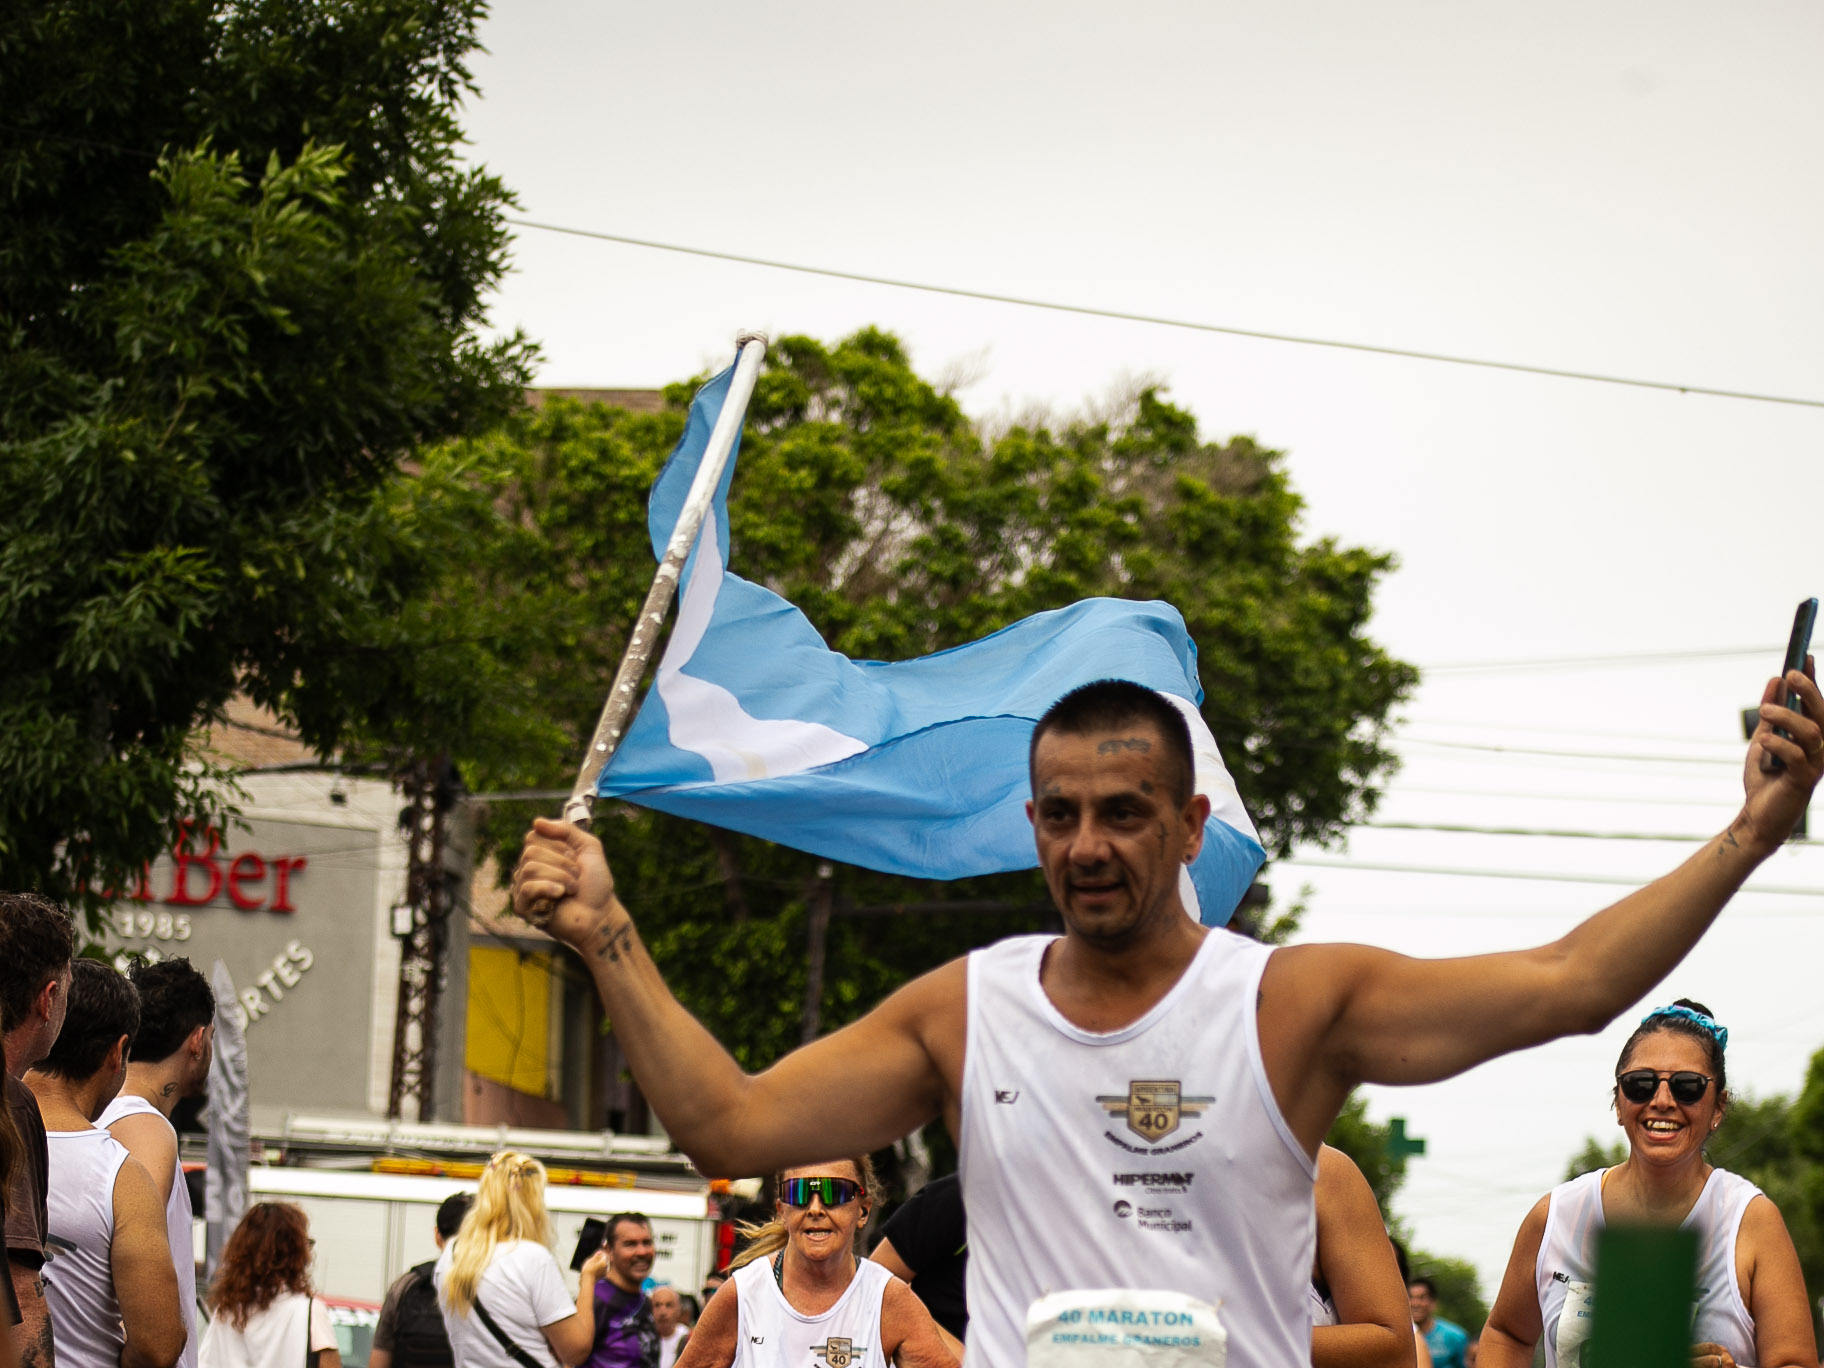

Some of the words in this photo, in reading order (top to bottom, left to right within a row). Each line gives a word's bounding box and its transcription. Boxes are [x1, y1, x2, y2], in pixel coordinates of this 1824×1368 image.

[118, 911, 192, 941] 1985
[1139, 1113, 1169, 1130] 40
[1137, 1207, 1172, 1218] Banco
[1137, 1219, 1192, 1233] Municipal
[1057, 1310, 1082, 1325] 40
[1089, 1310, 1194, 1327] MARATON
[1053, 1332, 1118, 1345] EMPALME
[1123, 1333, 1201, 1348] GRANEROS
[832, 1355, 846, 1365] 40
